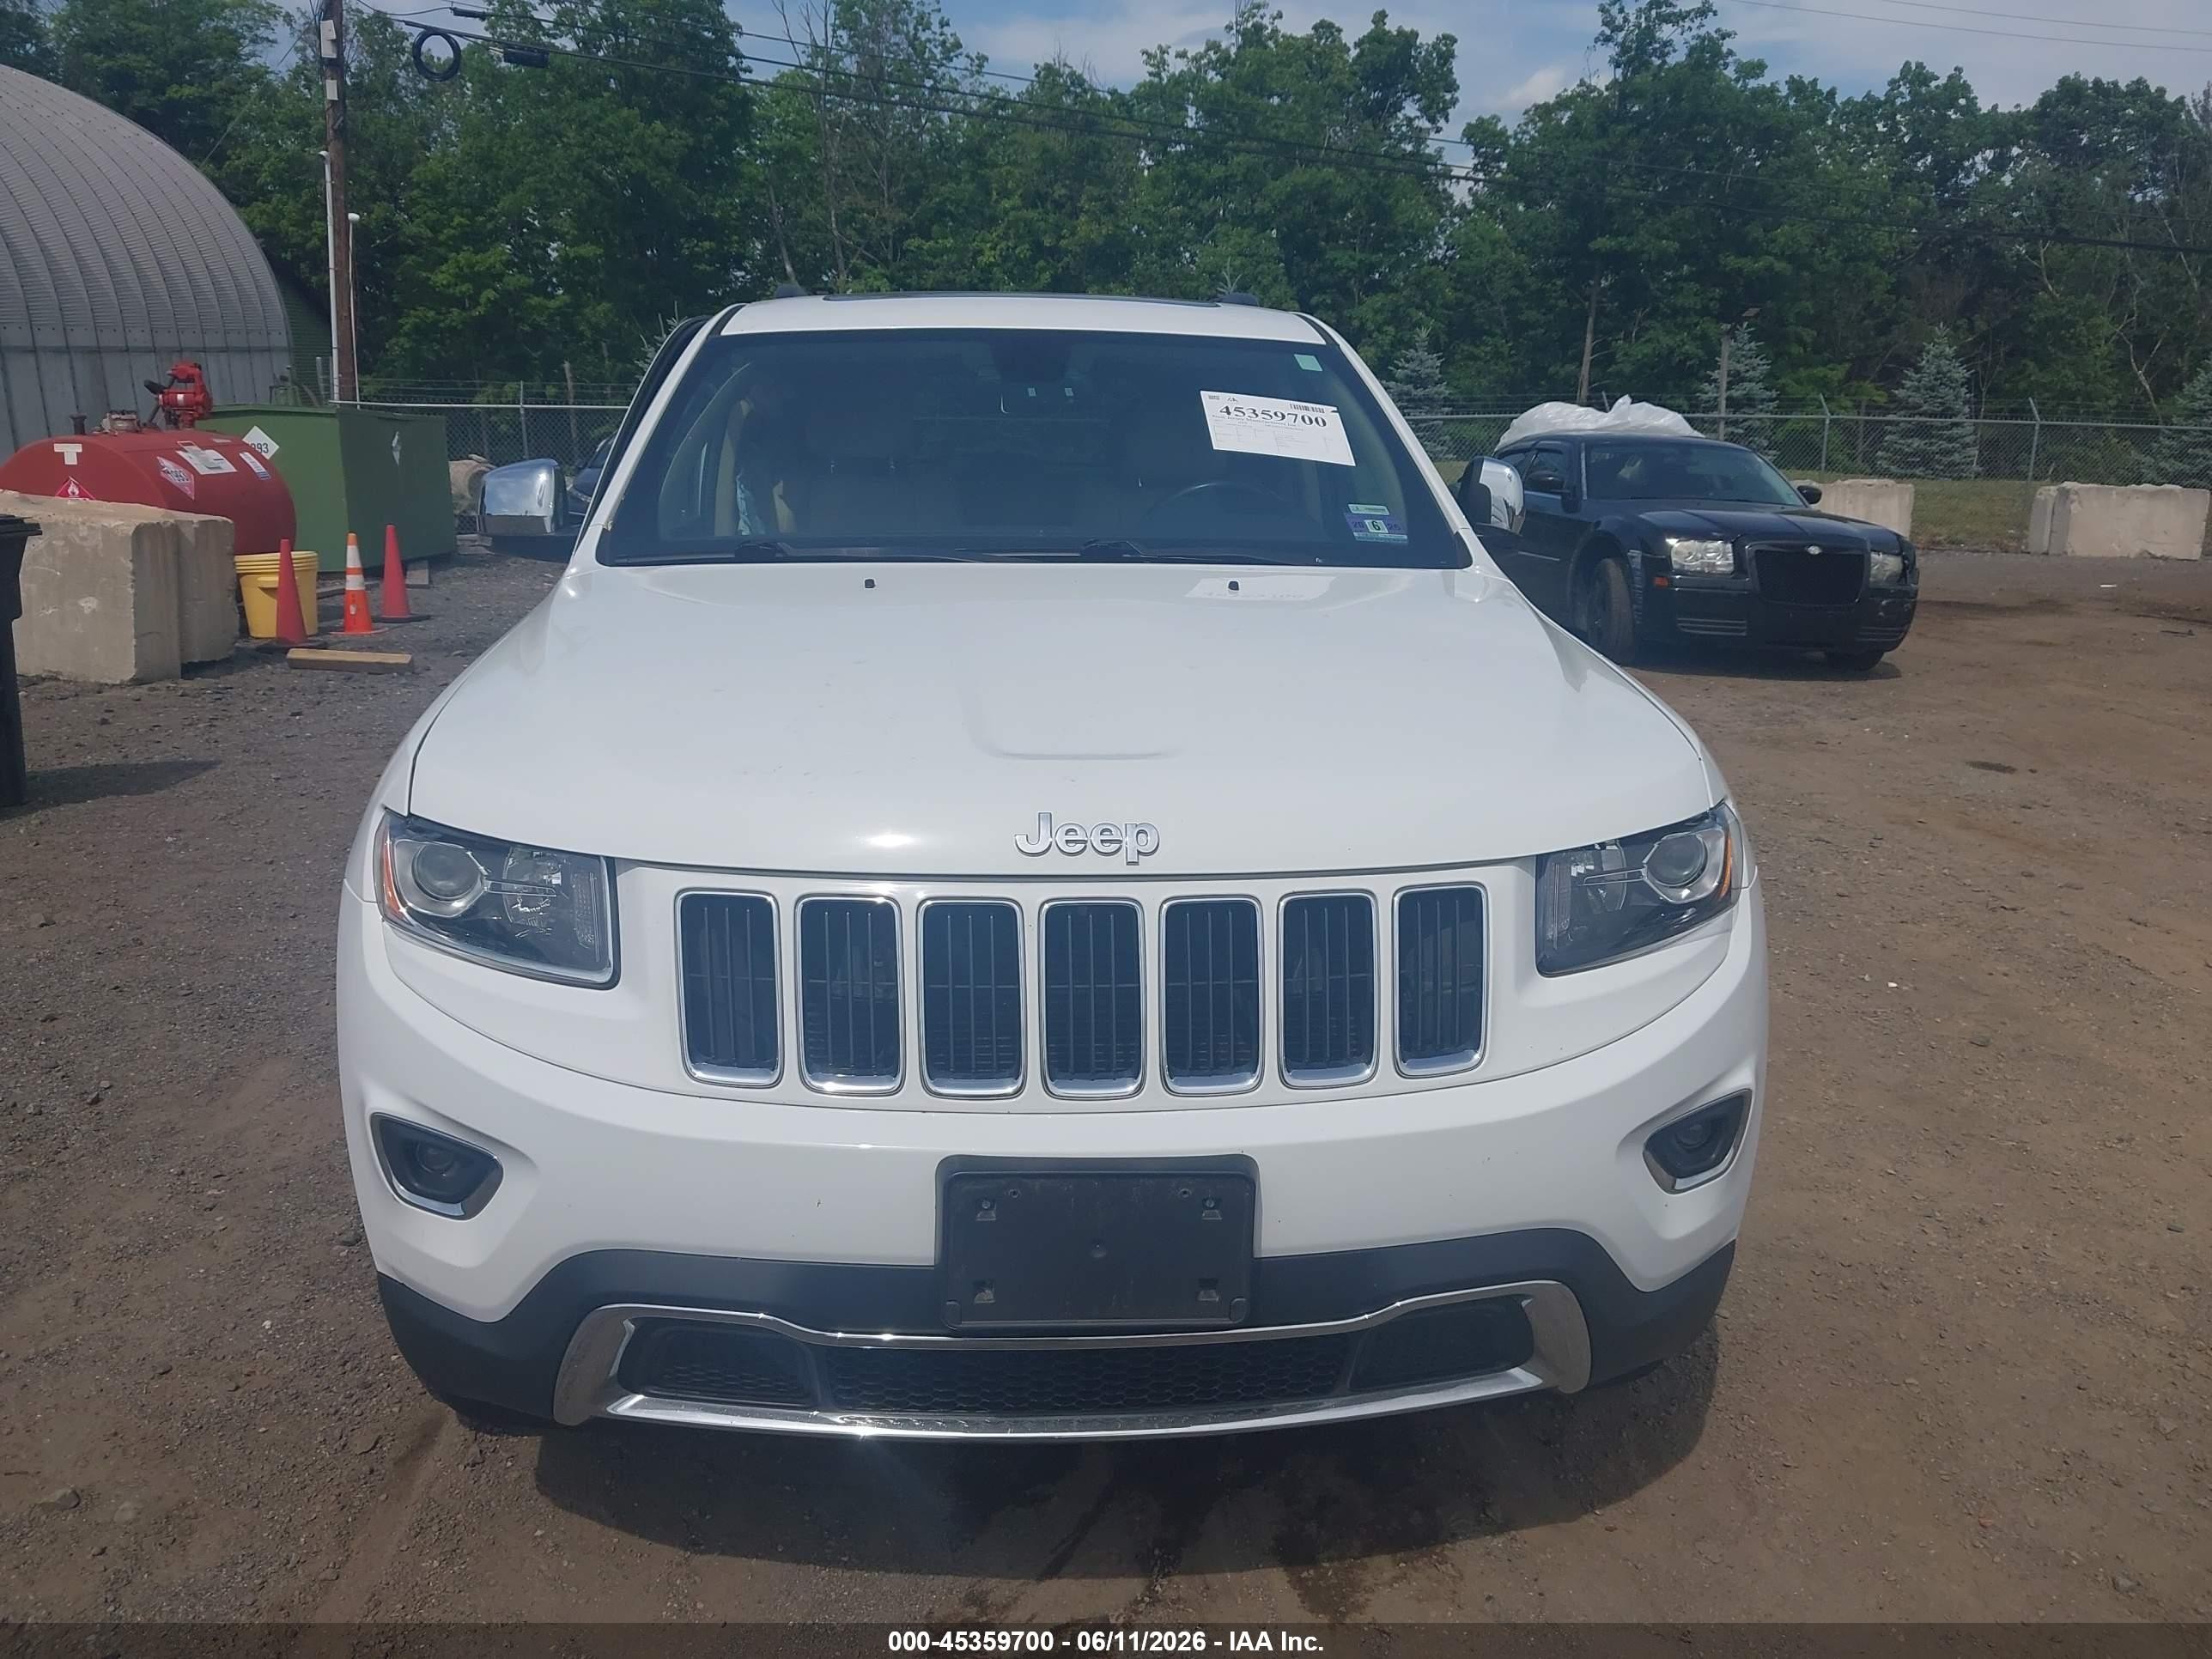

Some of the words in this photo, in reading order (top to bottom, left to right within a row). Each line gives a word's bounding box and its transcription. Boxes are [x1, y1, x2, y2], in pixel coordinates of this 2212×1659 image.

[1219, 405, 1327, 428] 45359700
[1371, 520, 1382, 531] 6
[1014, 811, 1160, 866] Jeep
